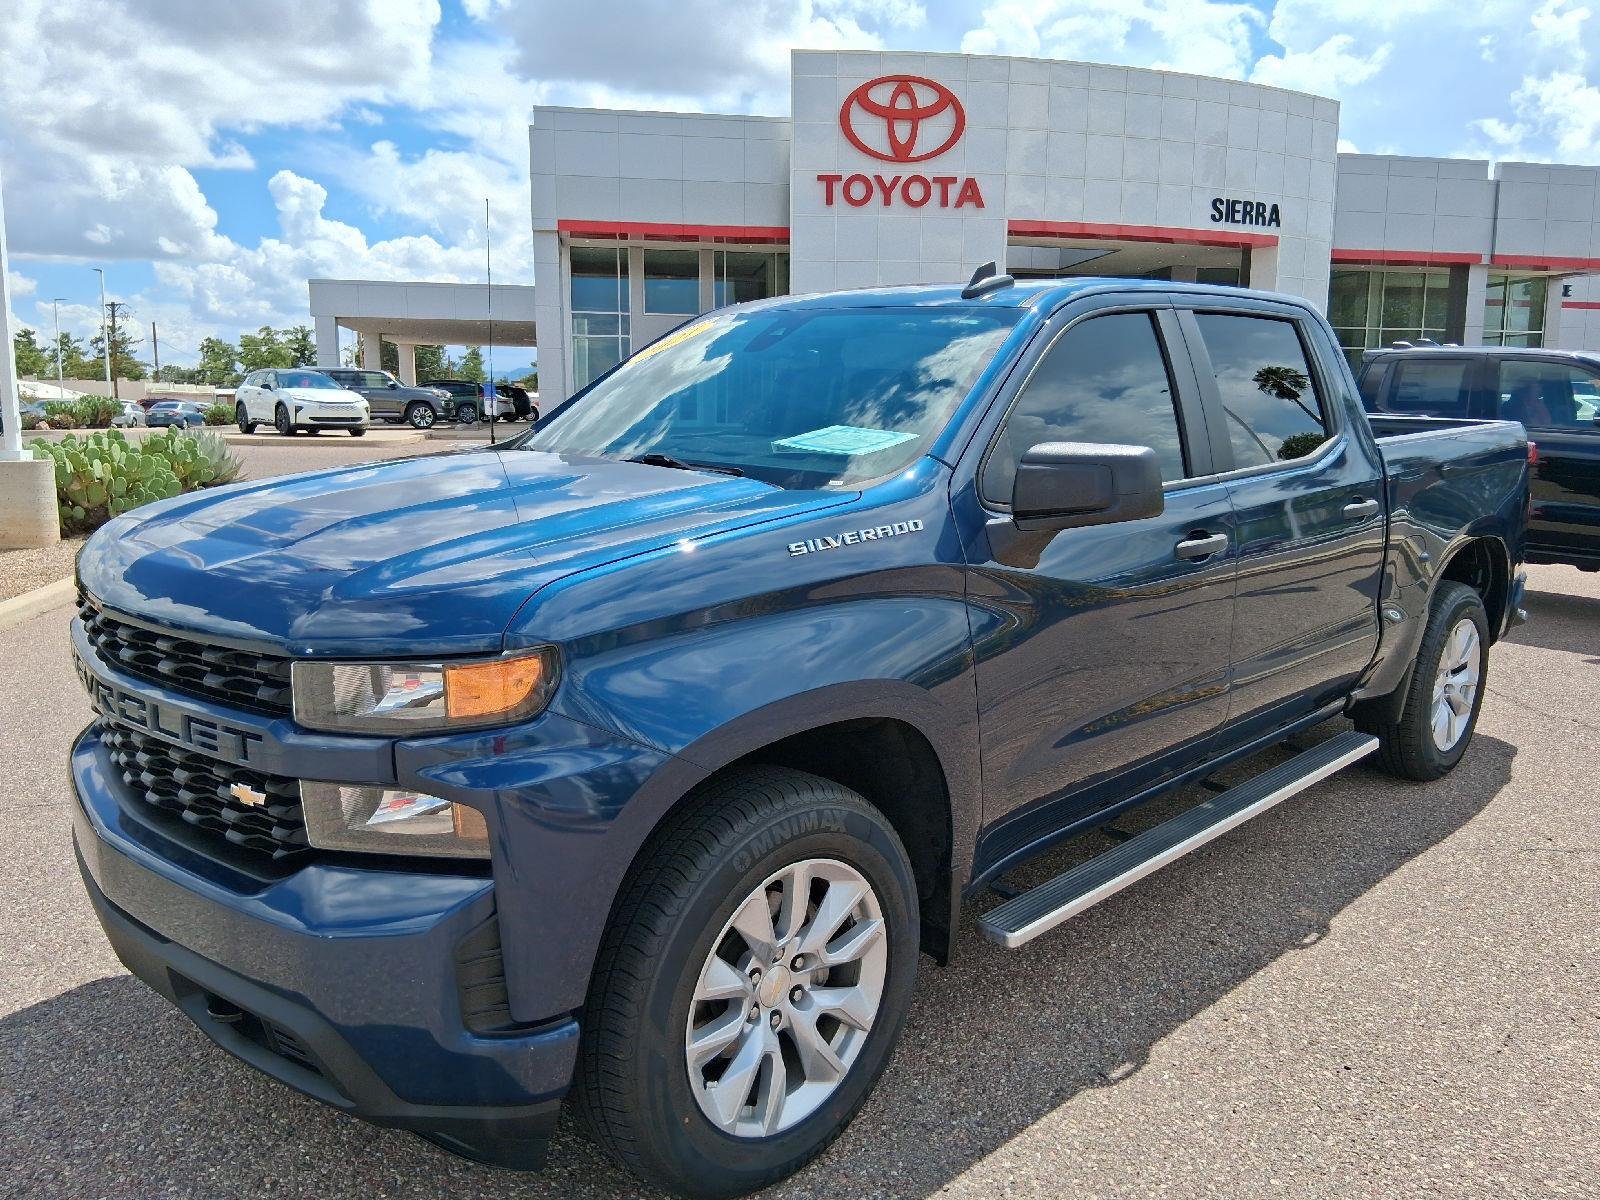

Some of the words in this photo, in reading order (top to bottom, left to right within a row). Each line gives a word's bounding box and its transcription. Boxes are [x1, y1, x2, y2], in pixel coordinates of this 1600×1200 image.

[817, 174, 985, 209] TOYOTA
[1211, 197, 1281, 228] SIERRA
[787, 519, 924, 557] SILVERADO
[72, 650, 263, 761] EVROLET
